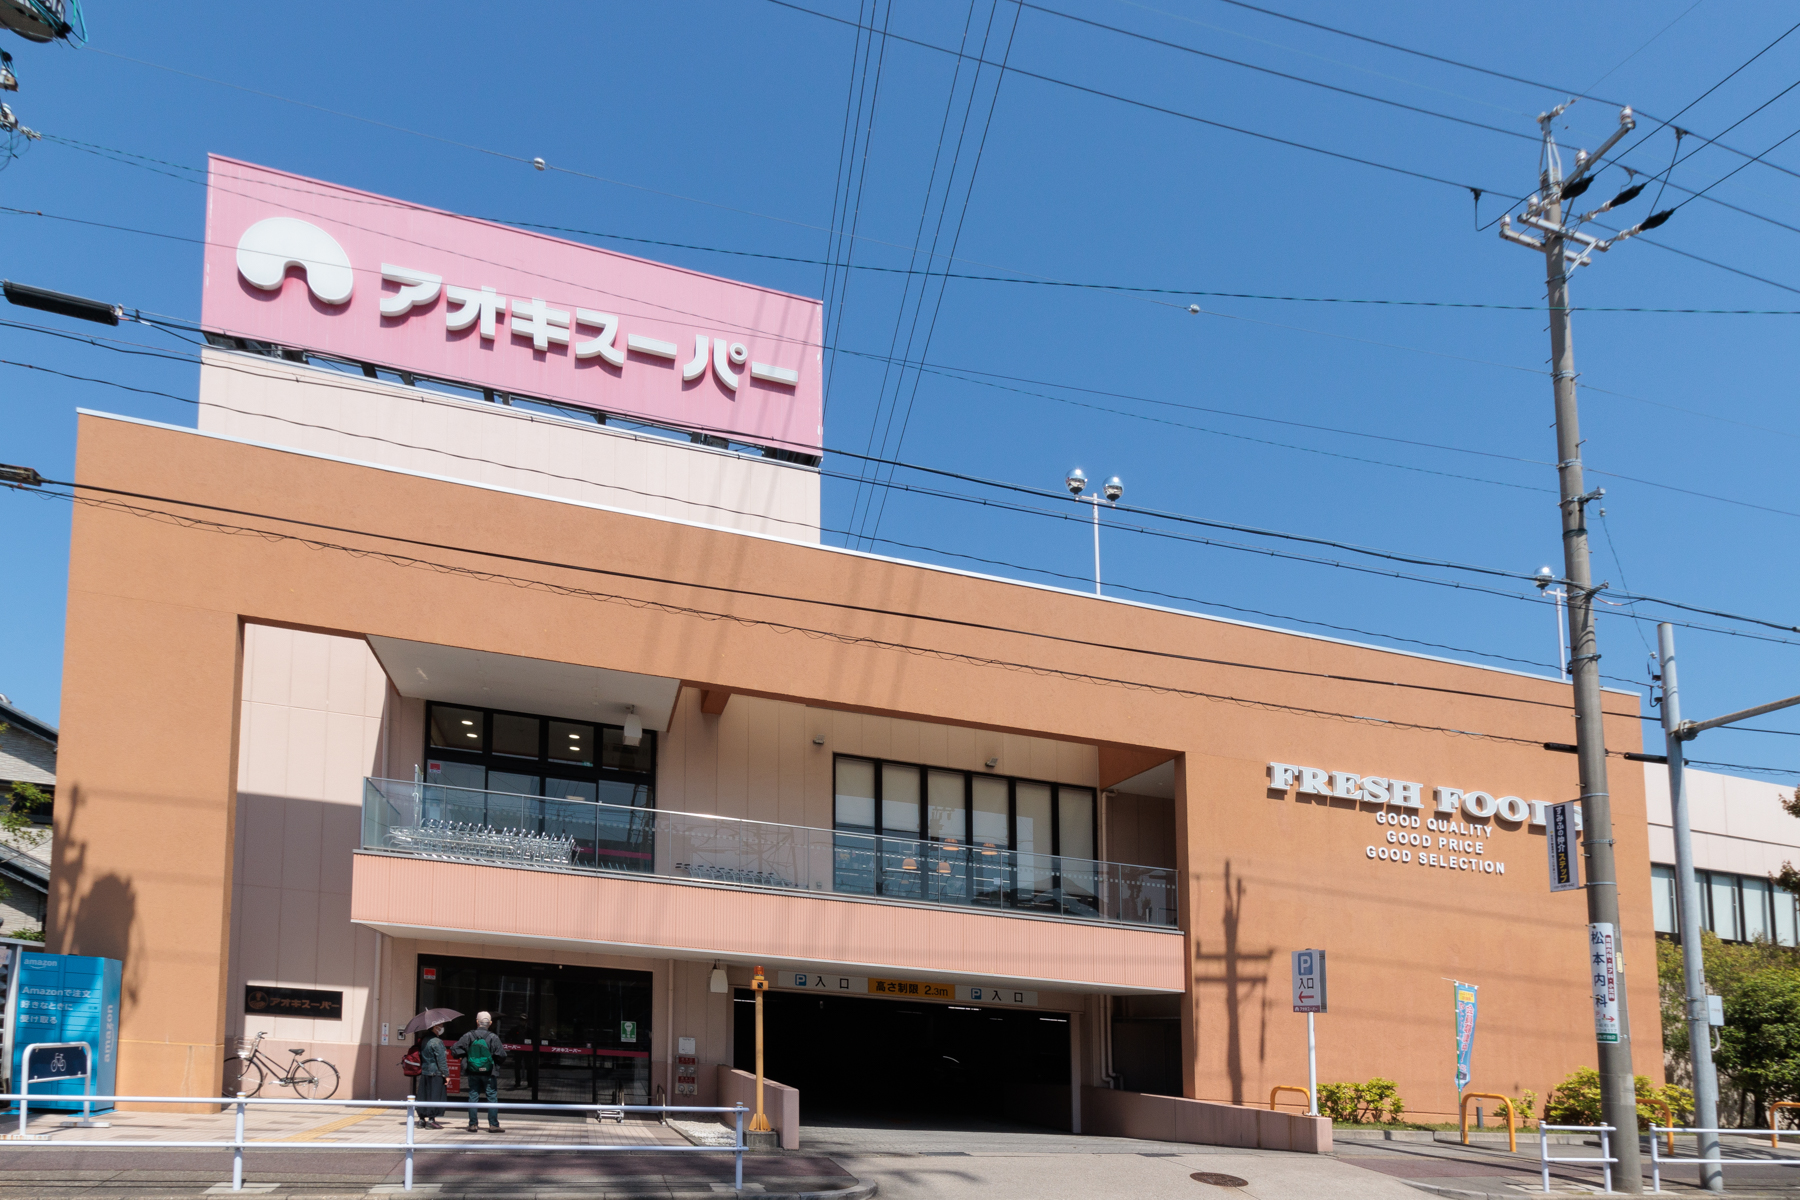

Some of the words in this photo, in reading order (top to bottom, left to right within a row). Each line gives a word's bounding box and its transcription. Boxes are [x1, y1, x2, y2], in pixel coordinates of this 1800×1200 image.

[380, 263, 799, 392] アオキスーパー
[1267, 762, 1424, 809] FRESH
[1434, 786, 1583, 831] FOO
[1376, 811, 1420, 828] GOOD
[1427, 818, 1493, 838] QUALITY
[1386, 830, 1431, 847] GOOD
[1438, 837, 1484, 854] PRICE
[1366, 846, 1411, 862] GOOD
[1418, 852, 1505, 874] SELECTION
[23, 958, 58, 967] amazon
[1300, 955, 1311, 974] P
[1591, 931, 1608, 1008] 松本内科
[815, 975, 849, 990] 入口
[876, 980, 919, 995] 高さ制限
[924, 985, 948, 997] 2.3m
[1298, 977, 1314, 990] 入口
[22, 987, 91, 998] Amazonで注文
[992, 990, 1024, 1004] 入口
[20, 1000, 74, 1011] 好きなときに
[269, 997, 340, 1010] アオキスーパー
[20, 1014, 58, 1025] 受け取る
[104, 1004, 114, 1063] amazon
